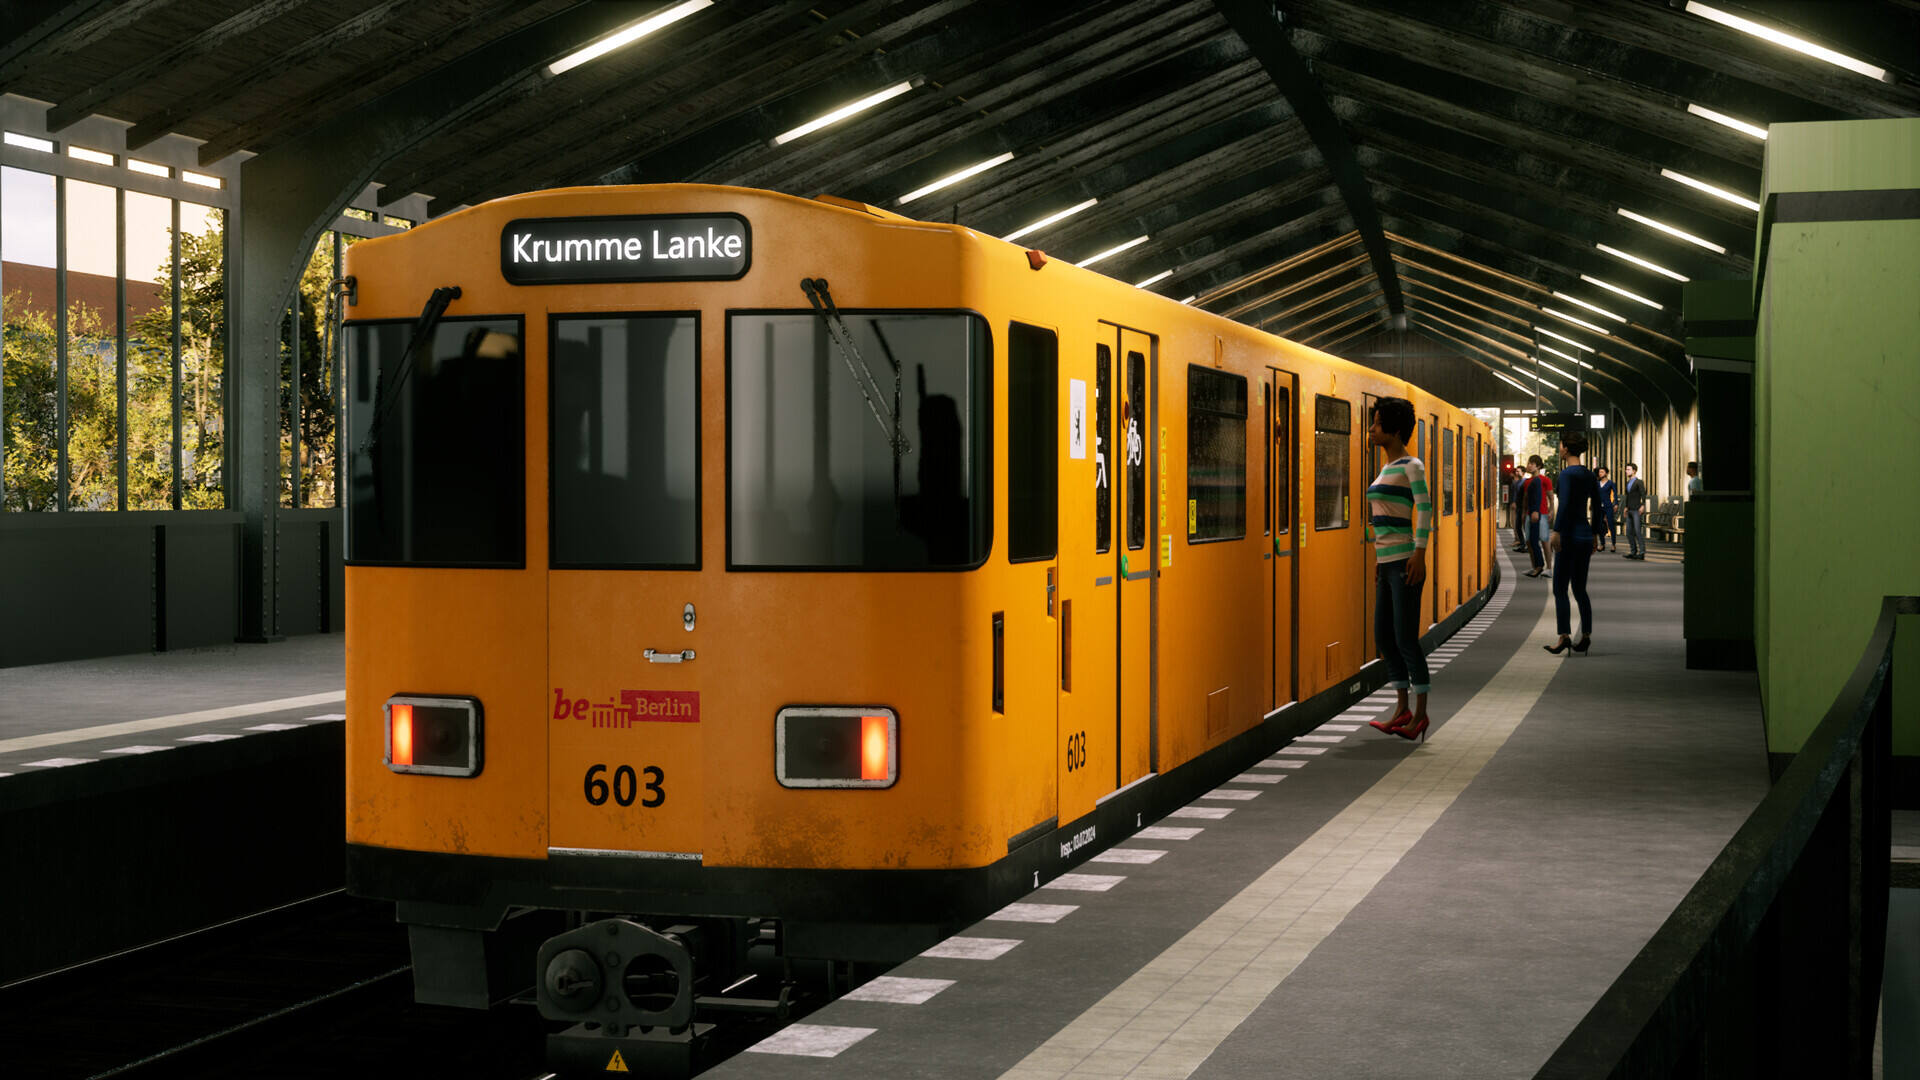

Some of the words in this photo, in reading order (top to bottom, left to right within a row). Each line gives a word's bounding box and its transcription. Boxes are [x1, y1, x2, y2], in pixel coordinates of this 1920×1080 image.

[513, 233, 642, 263] Krumme
[652, 227, 742, 259] Lanke
[553, 688, 590, 720] be
[635, 697, 692, 716] Berlin
[1067, 730, 1086, 773] 603
[584, 764, 666, 808] 603
